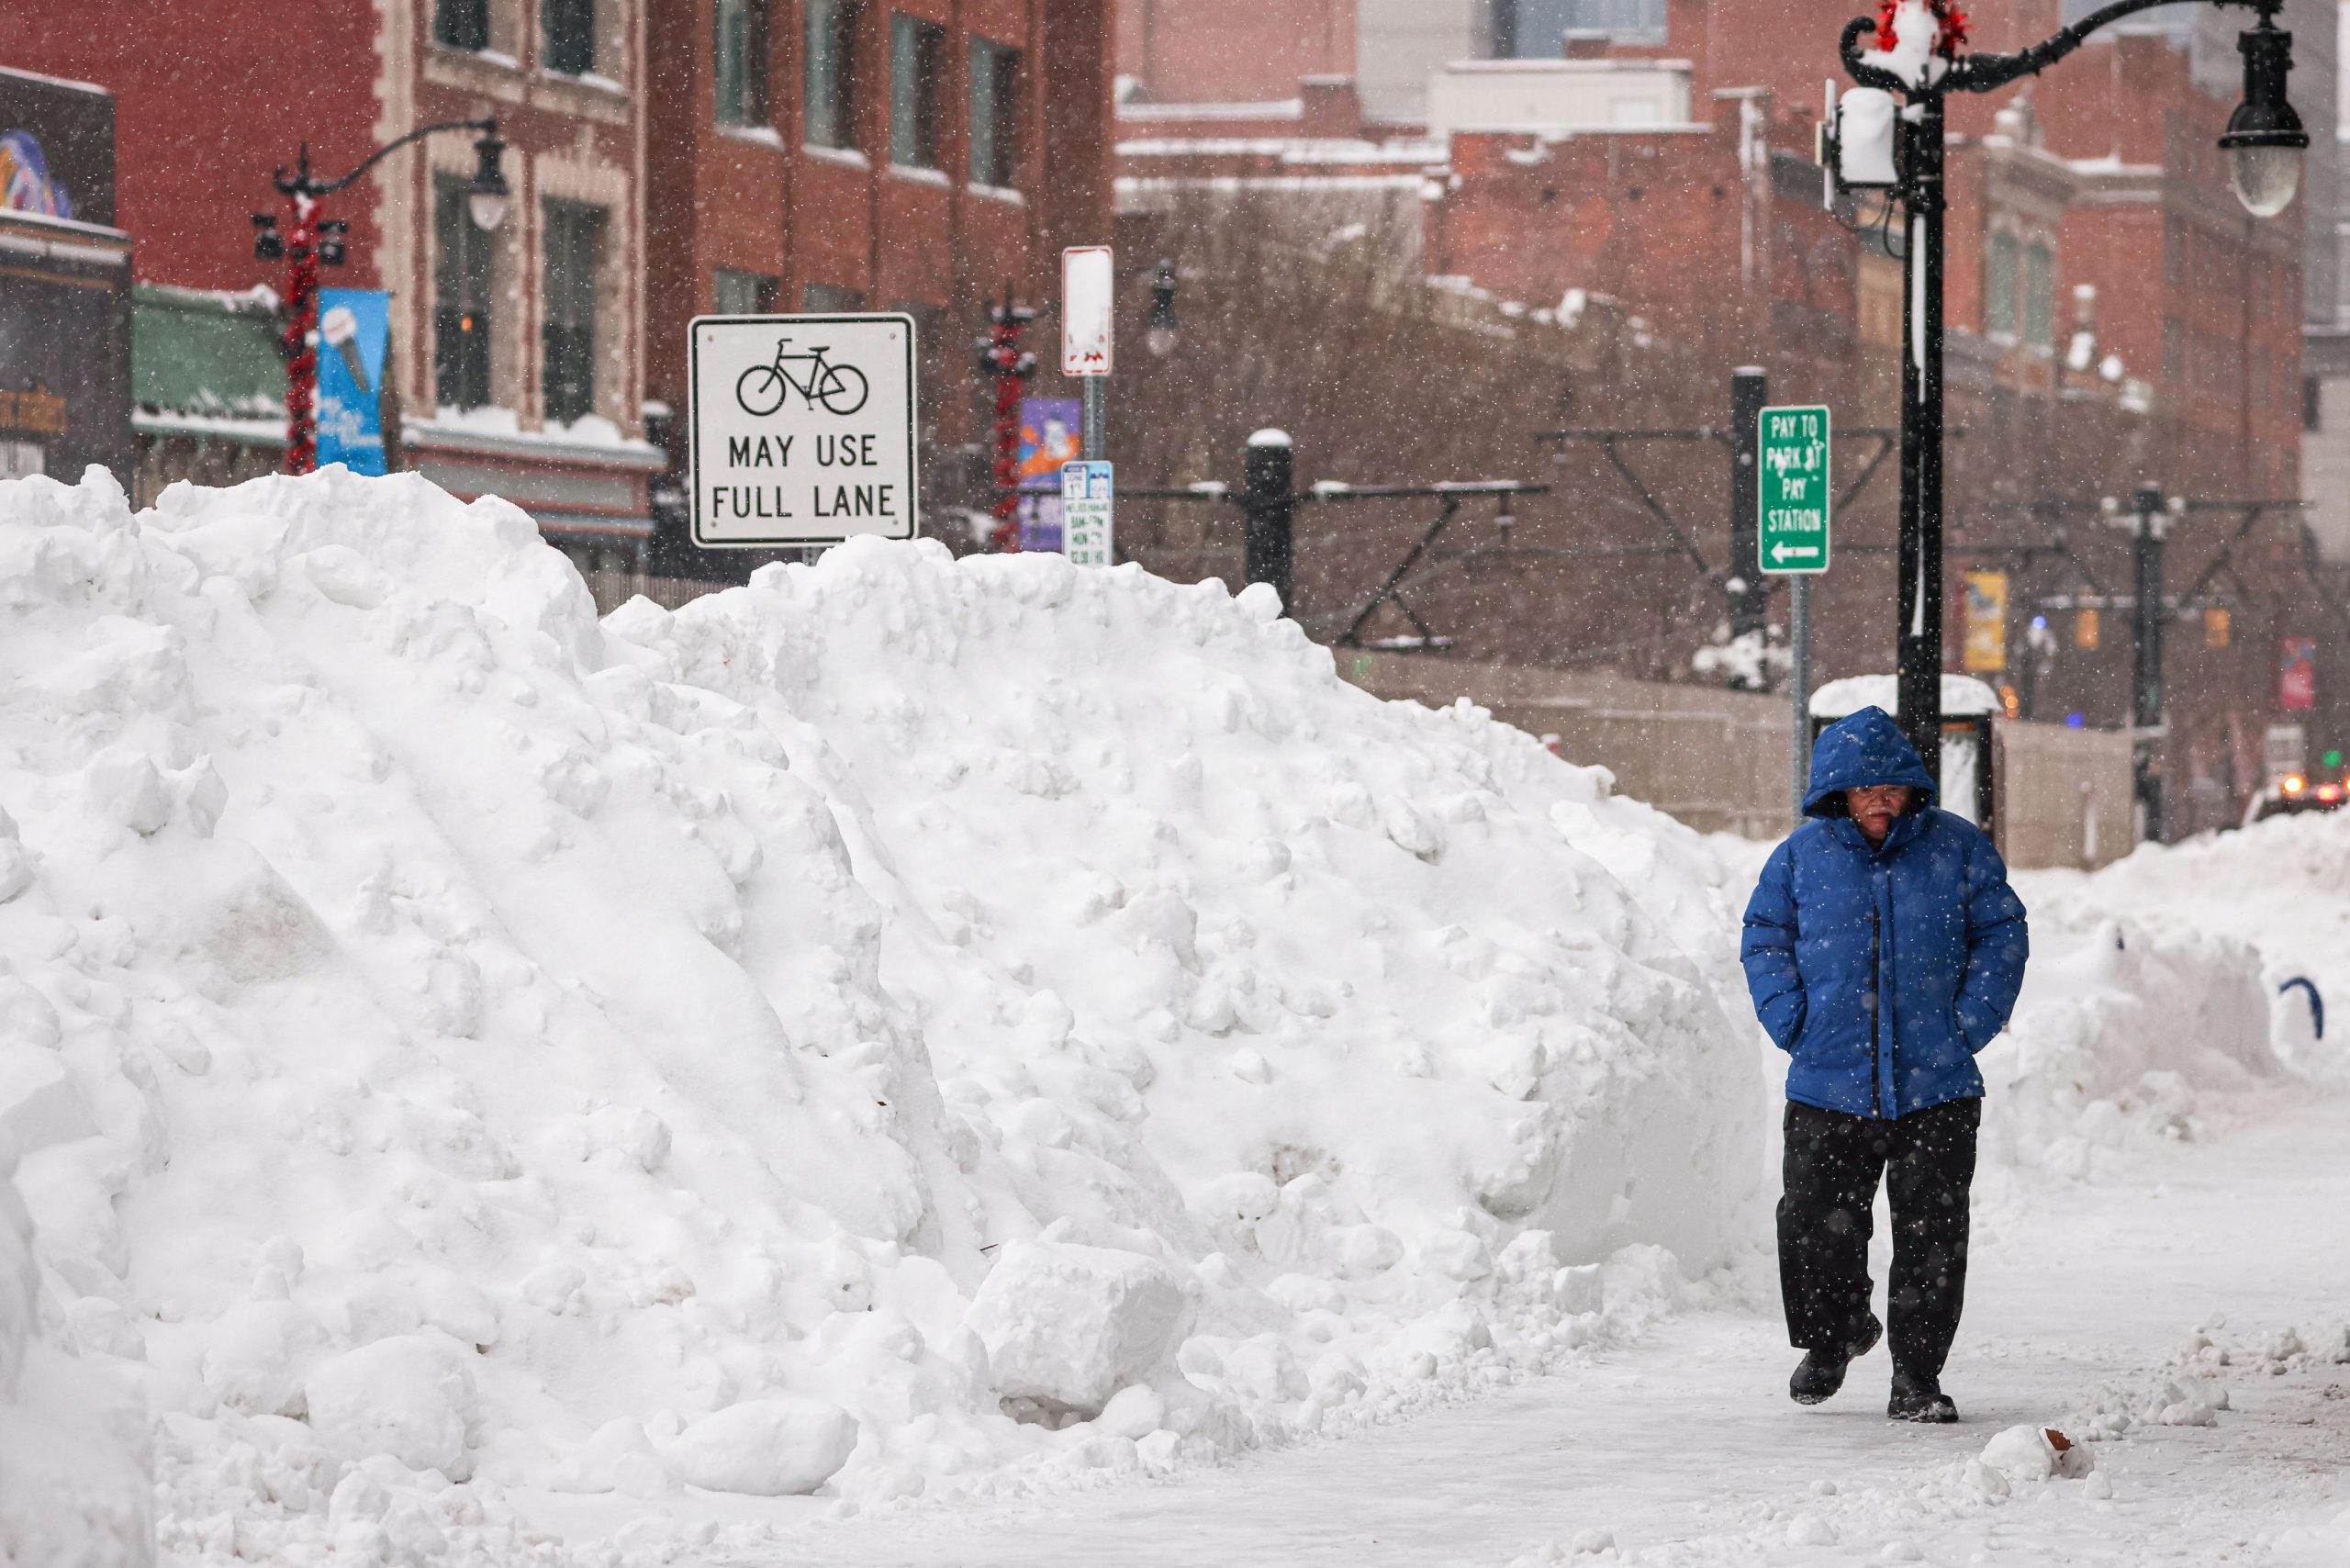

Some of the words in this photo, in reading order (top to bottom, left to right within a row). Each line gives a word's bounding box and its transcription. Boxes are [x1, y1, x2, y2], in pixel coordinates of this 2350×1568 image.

[1771, 415, 1796, 439] PAY
[1801, 414, 1818, 437] TO
[729, 435, 794, 467] MAY
[816, 433, 878, 466] USE
[1782, 476, 1807, 500] PAY
[712, 486, 792, 518] FULL
[814, 484, 896, 517] LANE
[1768, 509, 1821, 533] STATION
